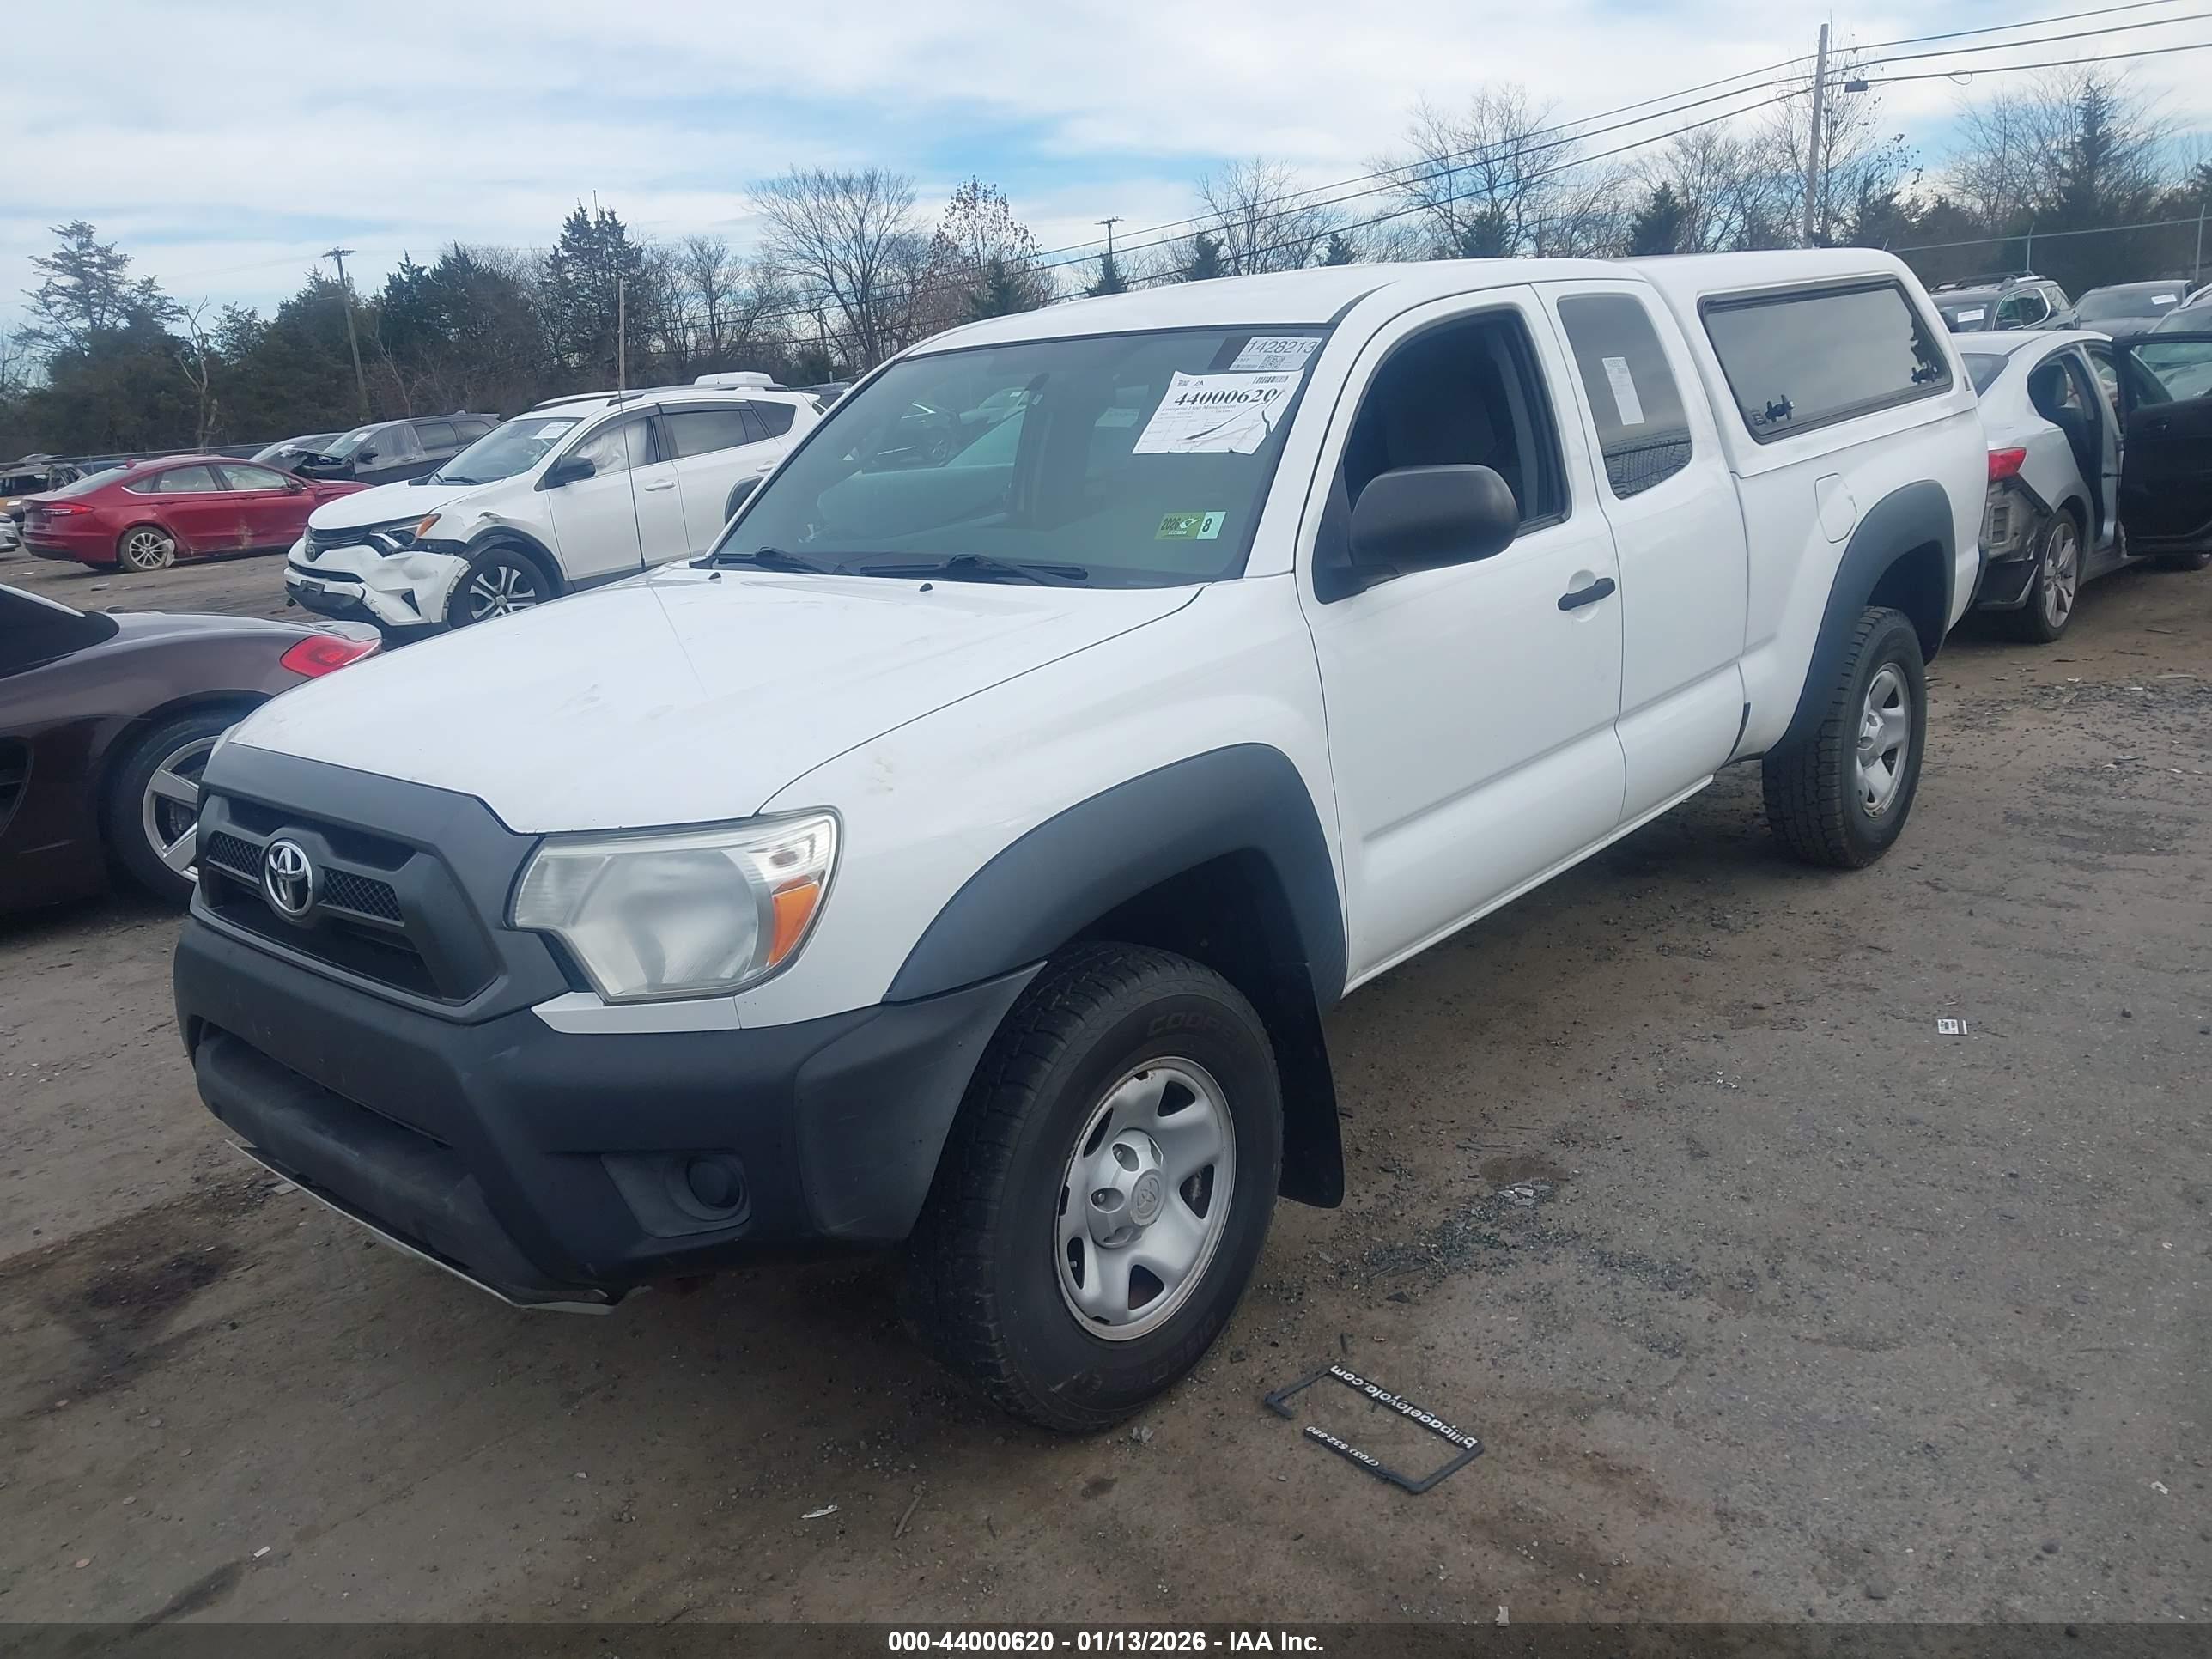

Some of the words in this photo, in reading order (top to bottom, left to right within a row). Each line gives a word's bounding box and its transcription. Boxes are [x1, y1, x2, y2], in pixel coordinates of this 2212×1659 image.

[1248, 340, 1319, 354] 1428213
[1174, 388, 1279, 405] 44000620
[1201, 518, 1213, 532] 8
[1329, 1365, 1479, 1449] billpagetoyota.com
[1348, 1449, 1380, 1468] (703)
